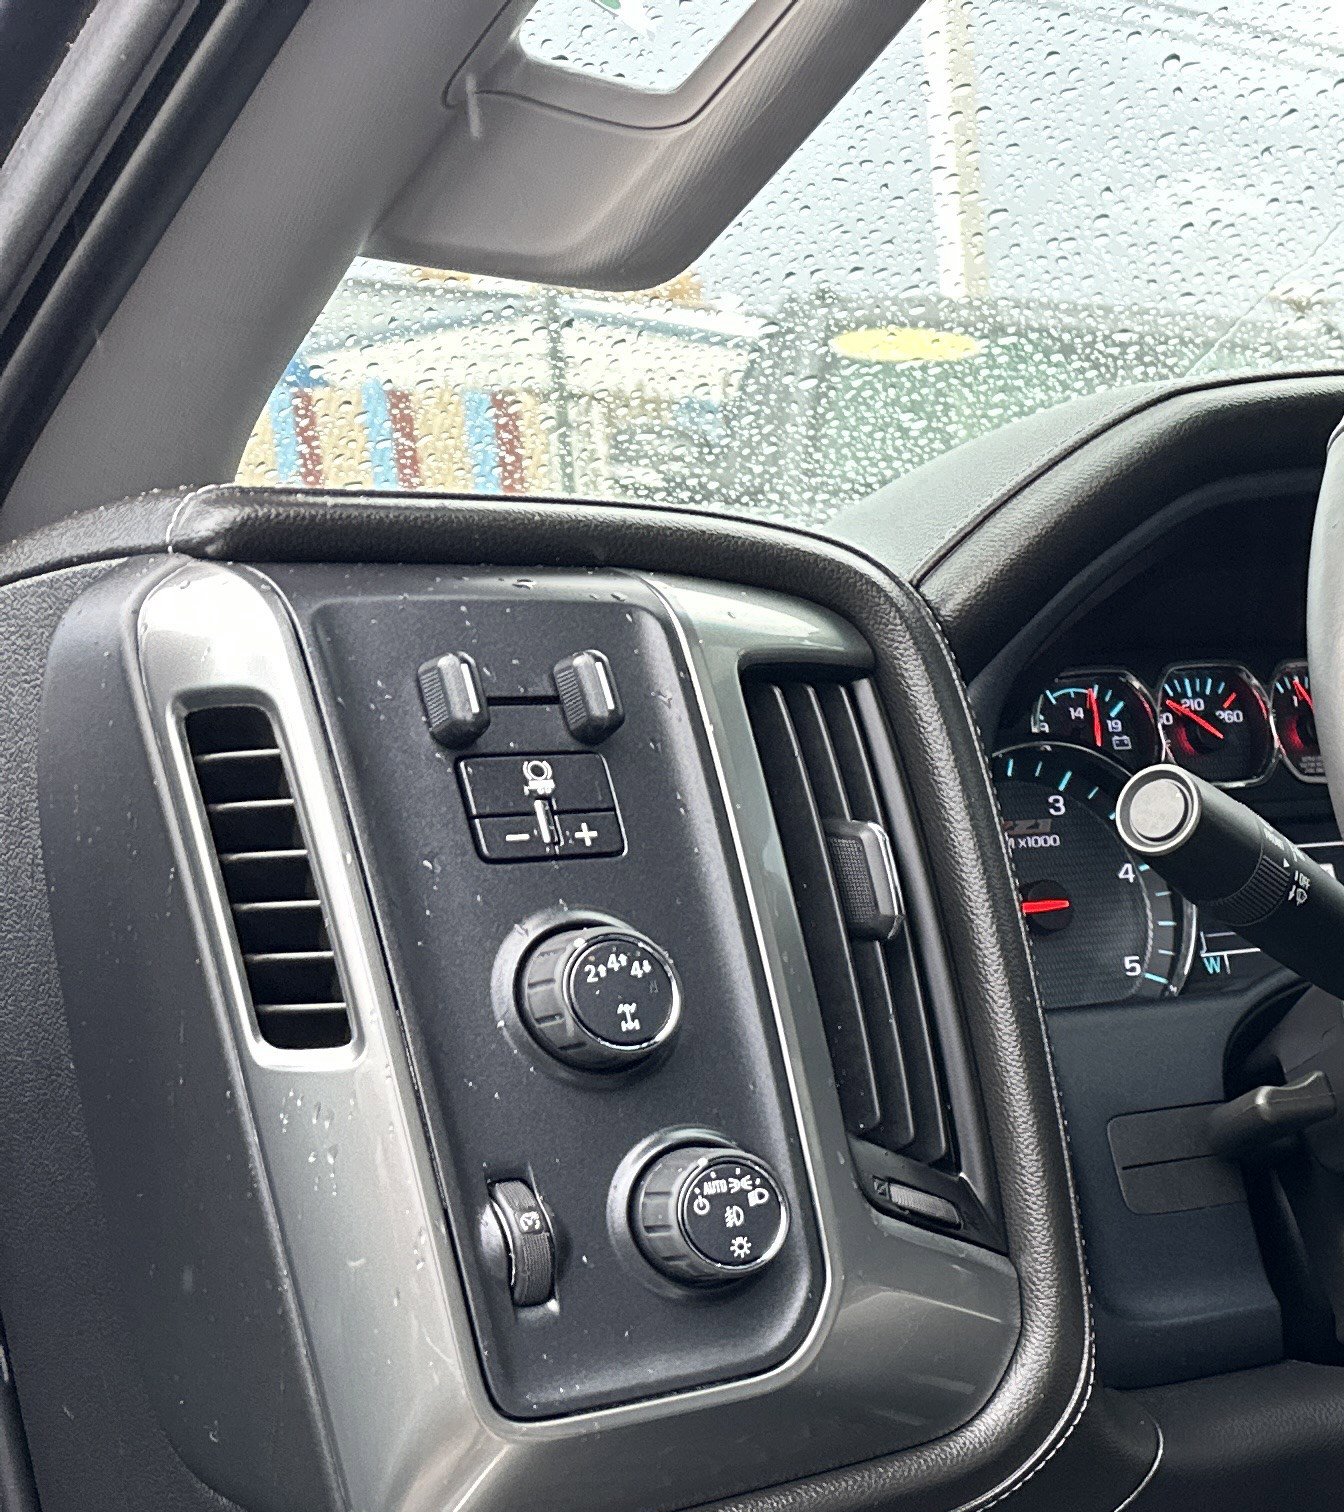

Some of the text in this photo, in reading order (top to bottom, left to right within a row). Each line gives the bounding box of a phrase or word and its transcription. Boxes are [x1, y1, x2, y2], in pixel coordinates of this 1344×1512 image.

[1181, 698, 1205, 712] 210
[1068, 706, 1085, 721] 14
[1106, 719, 1123, 733] 19
[1048, 795, 1066, 816] 3
[1018, 834, 1061, 849] x1000
[1118, 863, 1136, 883] 4
[1124, 955, 1142, 976] 5
[703, 1178, 728, 1196] AUTO
